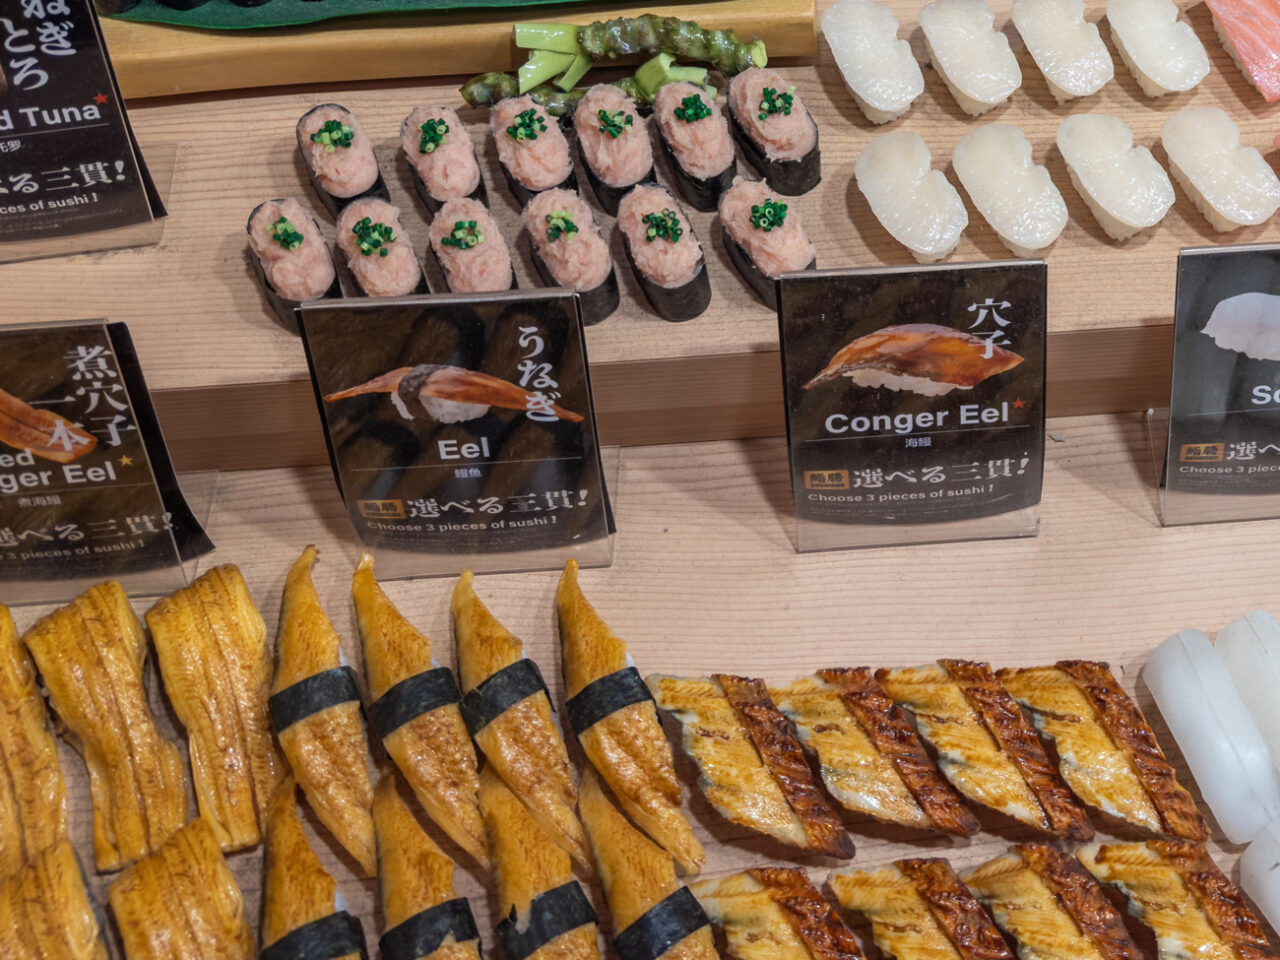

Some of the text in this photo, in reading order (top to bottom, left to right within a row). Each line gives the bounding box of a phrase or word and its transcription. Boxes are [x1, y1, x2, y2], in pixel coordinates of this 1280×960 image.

[20, 103, 101, 128] Tuna
[967, 298, 1012, 359] 穴子
[517, 326, 561, 423] うなぎ
[824, 401, 1009, 434] Conger Eel
[437, 436, 490, 460] Eel
[62, 461, 117, 485] Eel
[808, 492, 863, 503] Choose
[866, 492, 875, 501] 3
[878, 490, 925, 504] pieces
[929, 488, 944, 499] of
